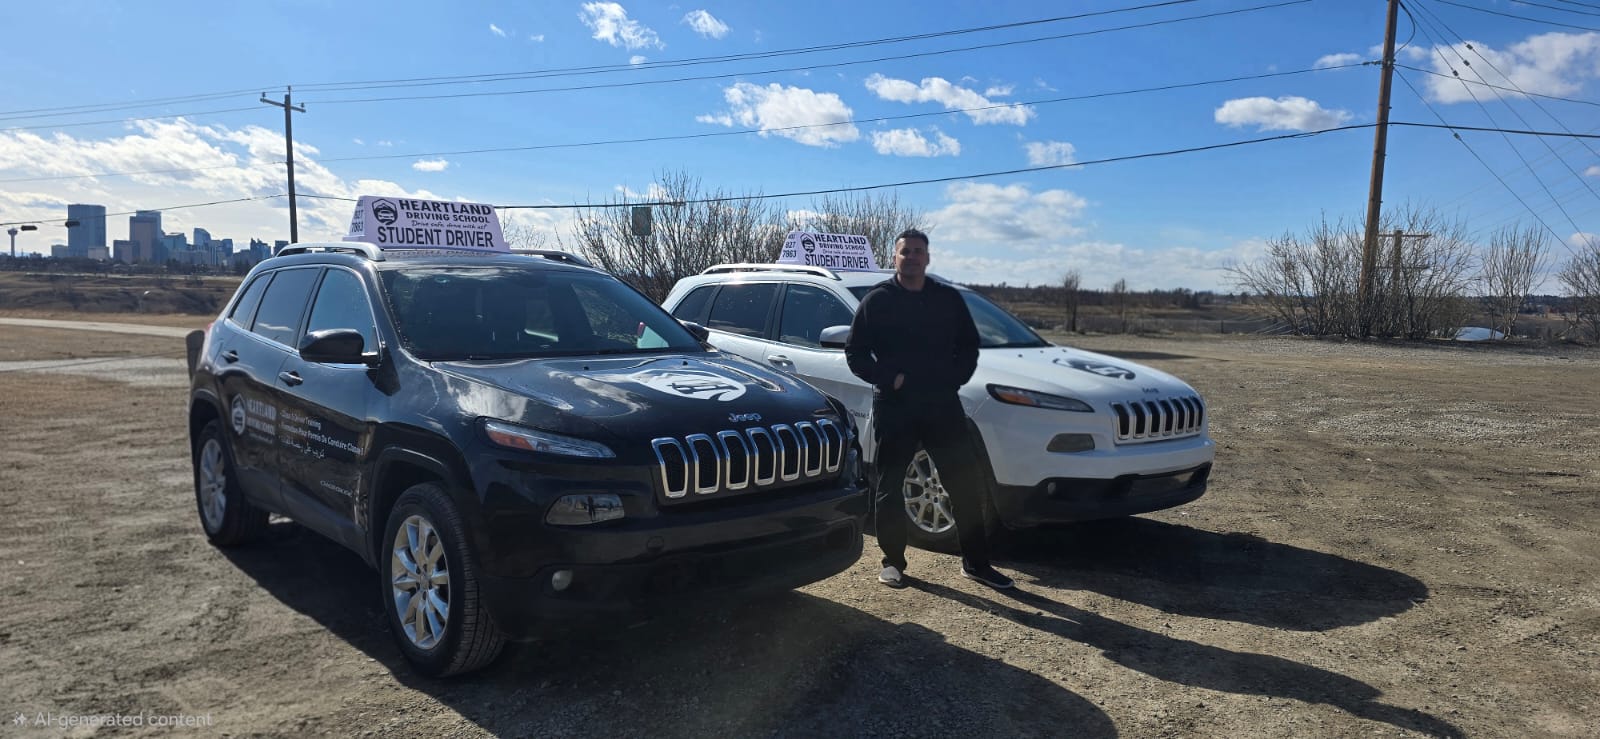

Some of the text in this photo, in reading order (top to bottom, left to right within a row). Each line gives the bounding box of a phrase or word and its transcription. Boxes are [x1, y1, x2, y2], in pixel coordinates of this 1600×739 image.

[399, 199, 492, 216] HEARTLAND
[405, 212, 490, 224] DRIVING SCHOOL
[377, 226, 494, 248] STUDENT DRIVER
[814, 233, 866, 245] HEARTLAND
[804, 253, 870, 269] STUDENT DRIVER
[728, 412, 762, 423] Jeep
